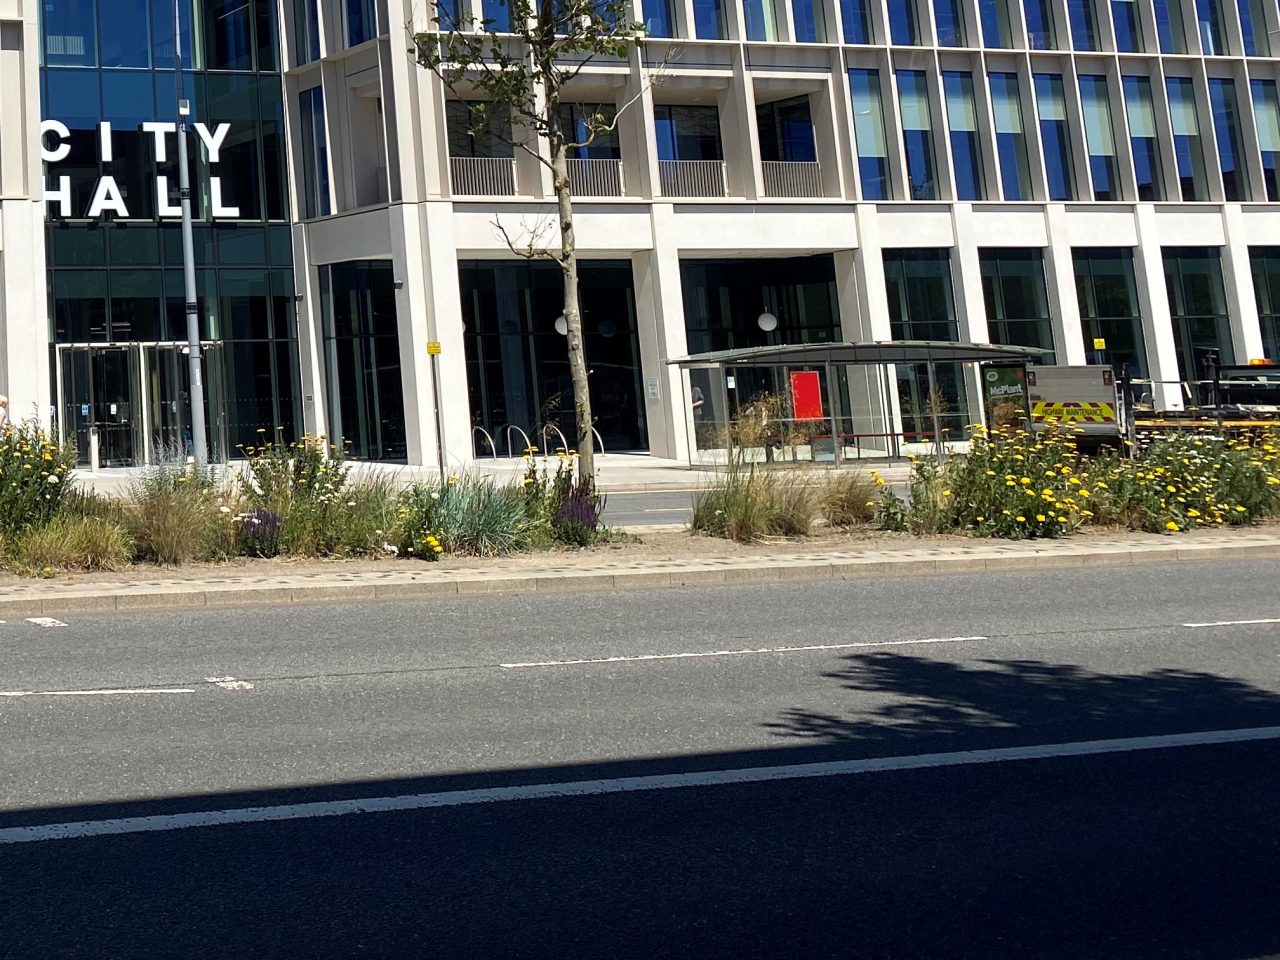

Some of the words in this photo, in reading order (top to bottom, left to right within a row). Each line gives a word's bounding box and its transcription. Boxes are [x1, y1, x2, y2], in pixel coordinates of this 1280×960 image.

[40, 119, 231, 163] CITY
[43, 175, 240, 217] HALL
[990, 384, 1023, 395] McPlant
[1041, 408, 1064, 417] HIGHWAY
[1066, 408, 1103, 417] MAINTENANCE
